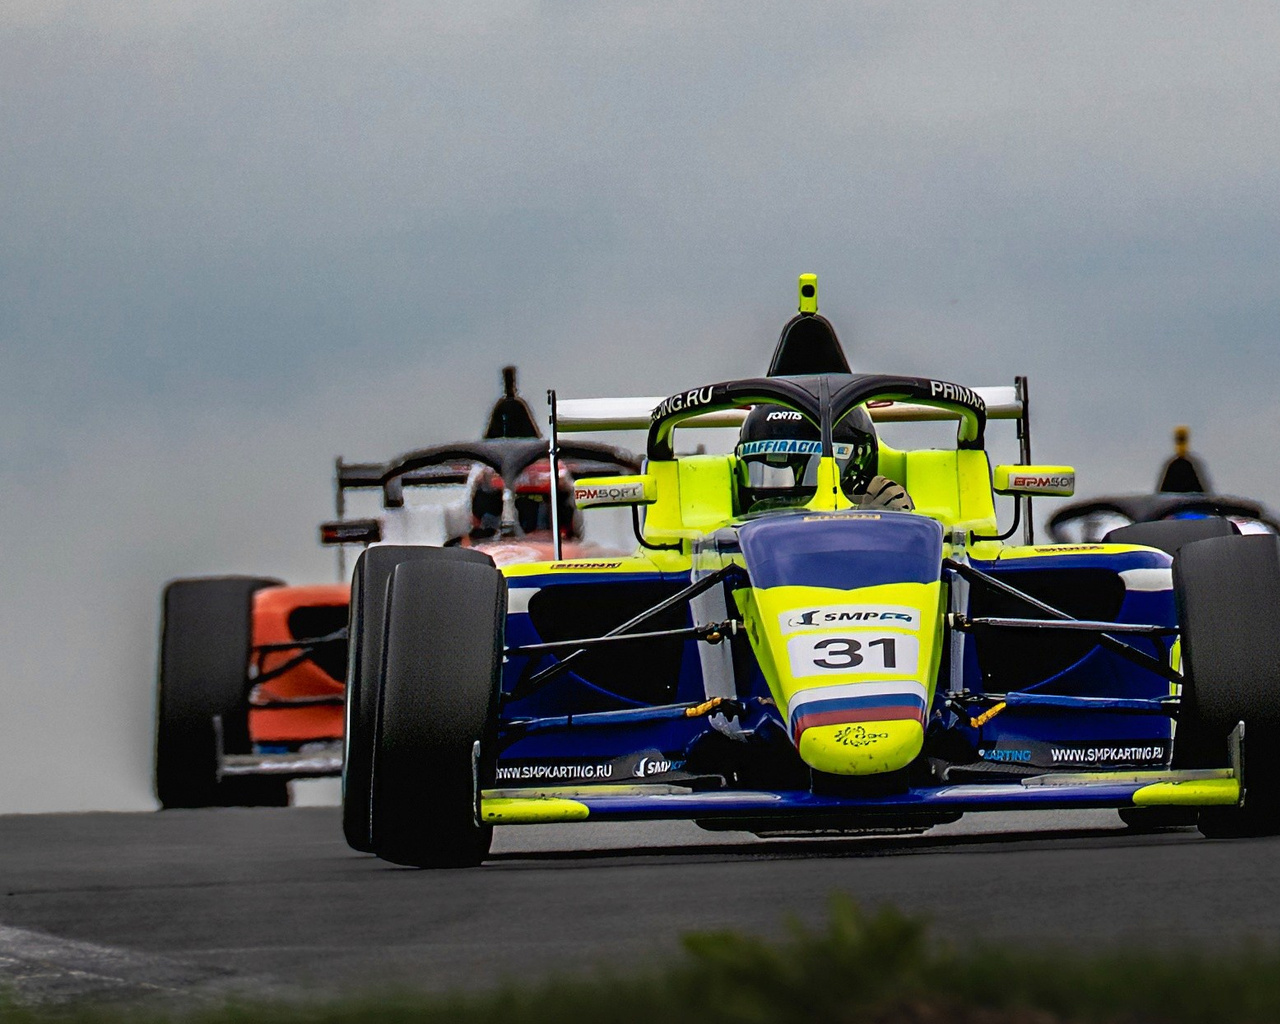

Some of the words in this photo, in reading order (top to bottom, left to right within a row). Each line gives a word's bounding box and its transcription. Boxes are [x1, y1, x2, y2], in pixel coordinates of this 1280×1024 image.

[766, 411, 802, 422] FORTIS
[813, 637, 897, 669] 31
[1051, 747, 1164, 762] WWW.SMPKARTING.RU
